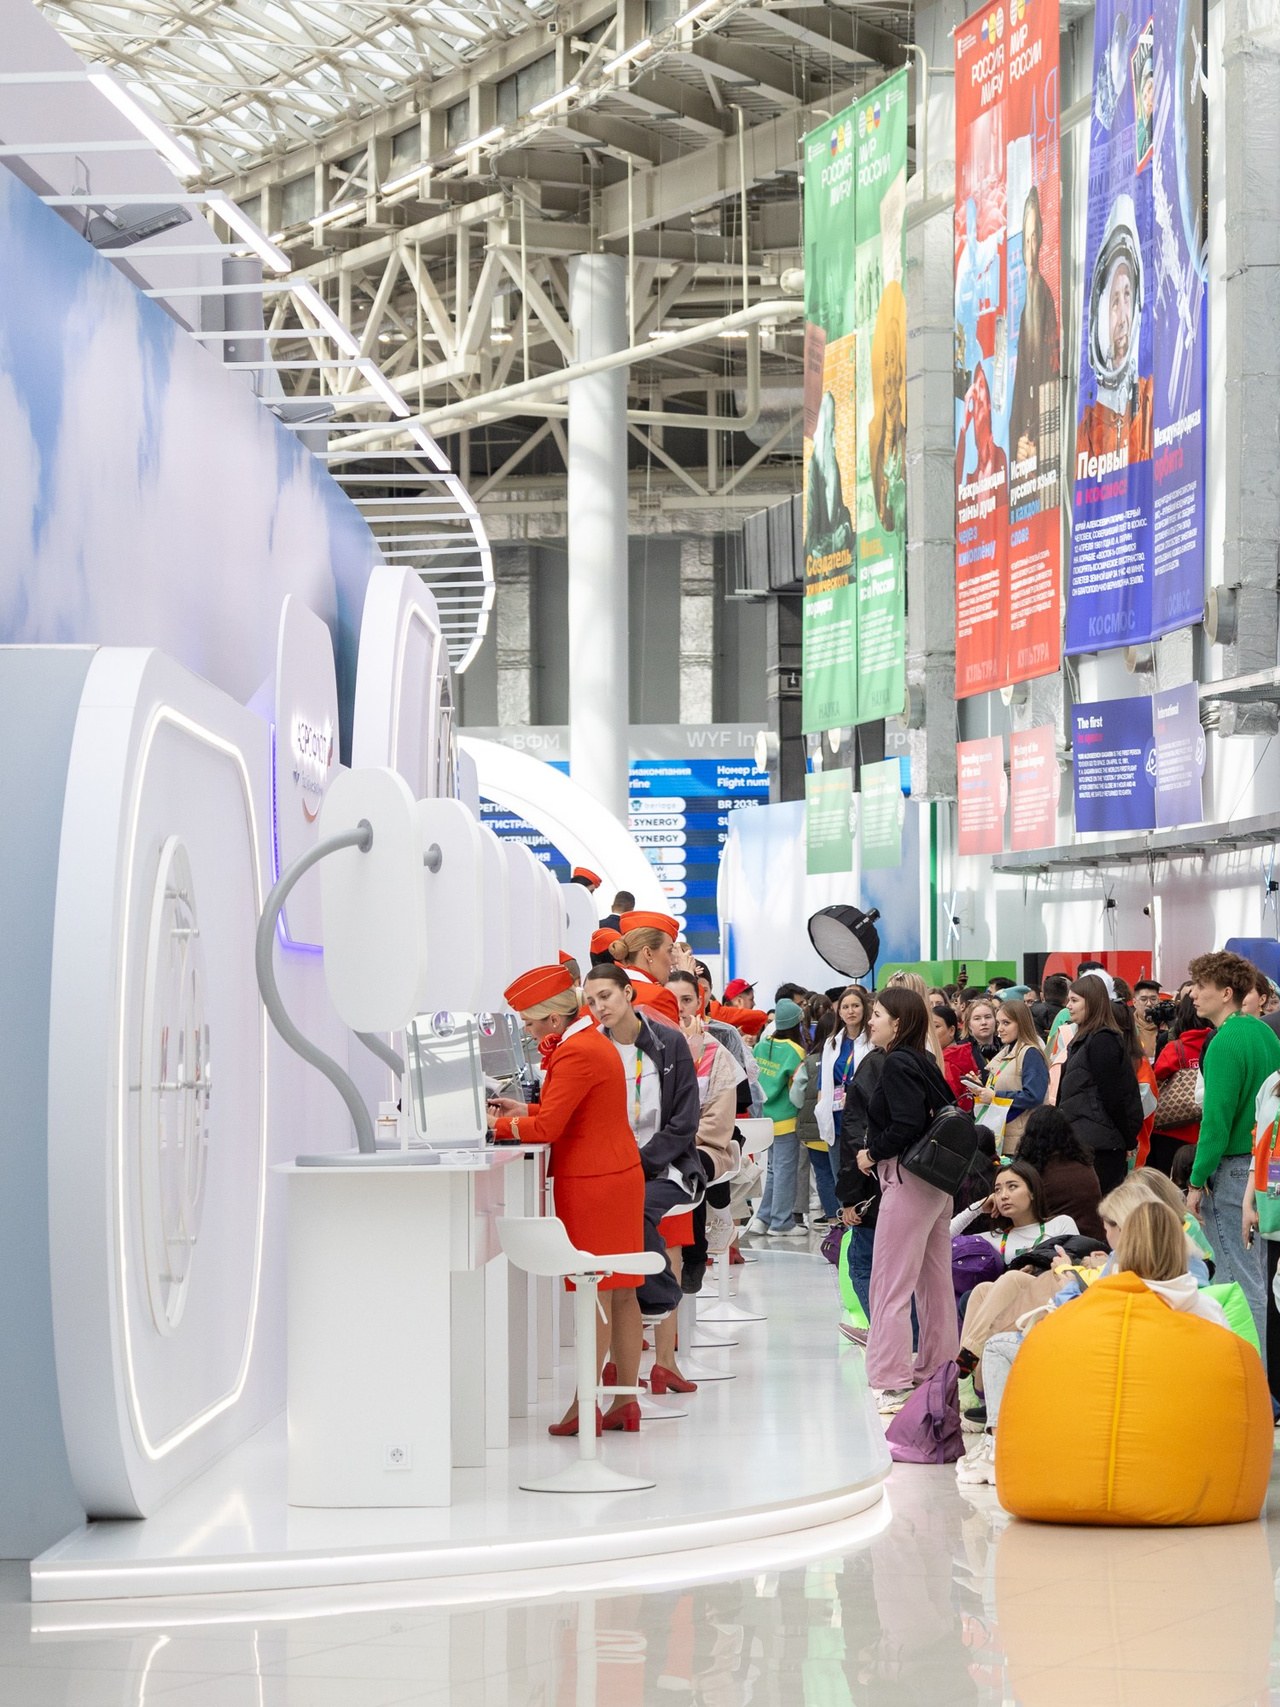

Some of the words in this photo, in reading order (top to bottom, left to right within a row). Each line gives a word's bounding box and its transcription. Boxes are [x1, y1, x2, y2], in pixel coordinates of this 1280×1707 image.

[1010, 24, 1028, 57] МИР
[972, 43, 1004, 87] РОССИЯ
[1010, 38, 1041, 84] РОССИИ
[981, 70, 1004, 107] МИРУ
[859, 137, 877, 164] МИР
[821, 152, 853, 189] РОССИЯ
[858, 152, 891, 189] РОССИИ
[830, 177, 852, 207] МИРУ
[1077, 438, 1128, 483] Первый
[806, 548, 851, 578] Создатель
[1088, 610, 1135, 638] КОСМОС
[1017, 642, 1049, 668] КУЛЬТУРА
[966, 658, 998, 684] КУЛЬТУРА
[818, 701, 841, 719] НАУКА
[1077, 717, 1089, 729] The
[1089, 716, 1103, 728] first
[513, 733, 560, 750] ВФМ
[686, 731, 732, 748] WYF
[629, 778, 651, 788] rline
[717, 777, 745, 789] Flight
[717, 766, 750, 776] Номер
[717, 800, 732, 809] BR
[734, 799, 759, 809] 2035
[634, 818, 679, 827] SYNERGY
[634, 835, 679, 844] SYNERGY
